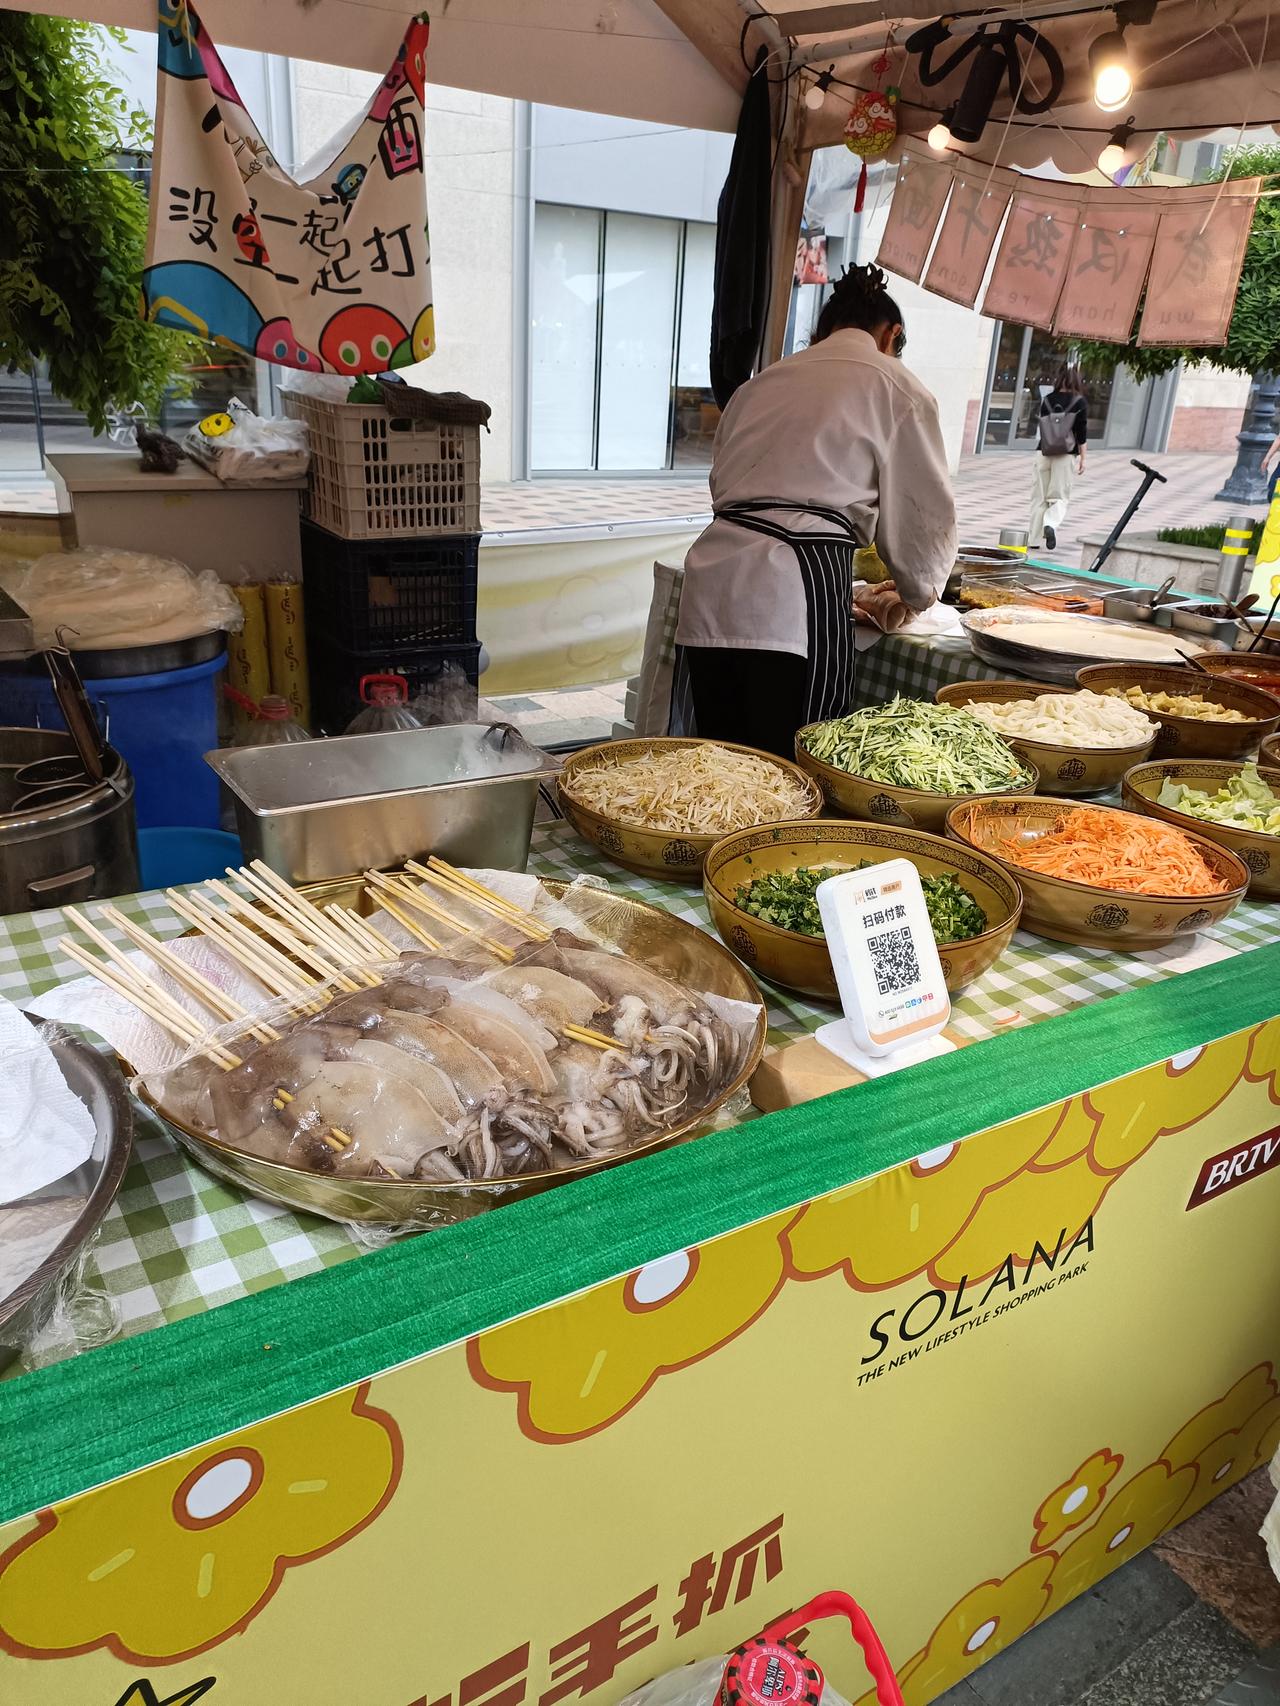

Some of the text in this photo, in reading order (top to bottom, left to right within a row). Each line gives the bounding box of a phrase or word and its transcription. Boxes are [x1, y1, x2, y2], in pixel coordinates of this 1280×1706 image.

[862, 904, 907, 929] 扫码付款
[1201, 1137, 1280, 1195] BRTV
[856, 1261, 1090, 1387] THE NEW LIFESTYLE SHOPPING PARK
[860, 1215, 1095, 1365] SOLANA
